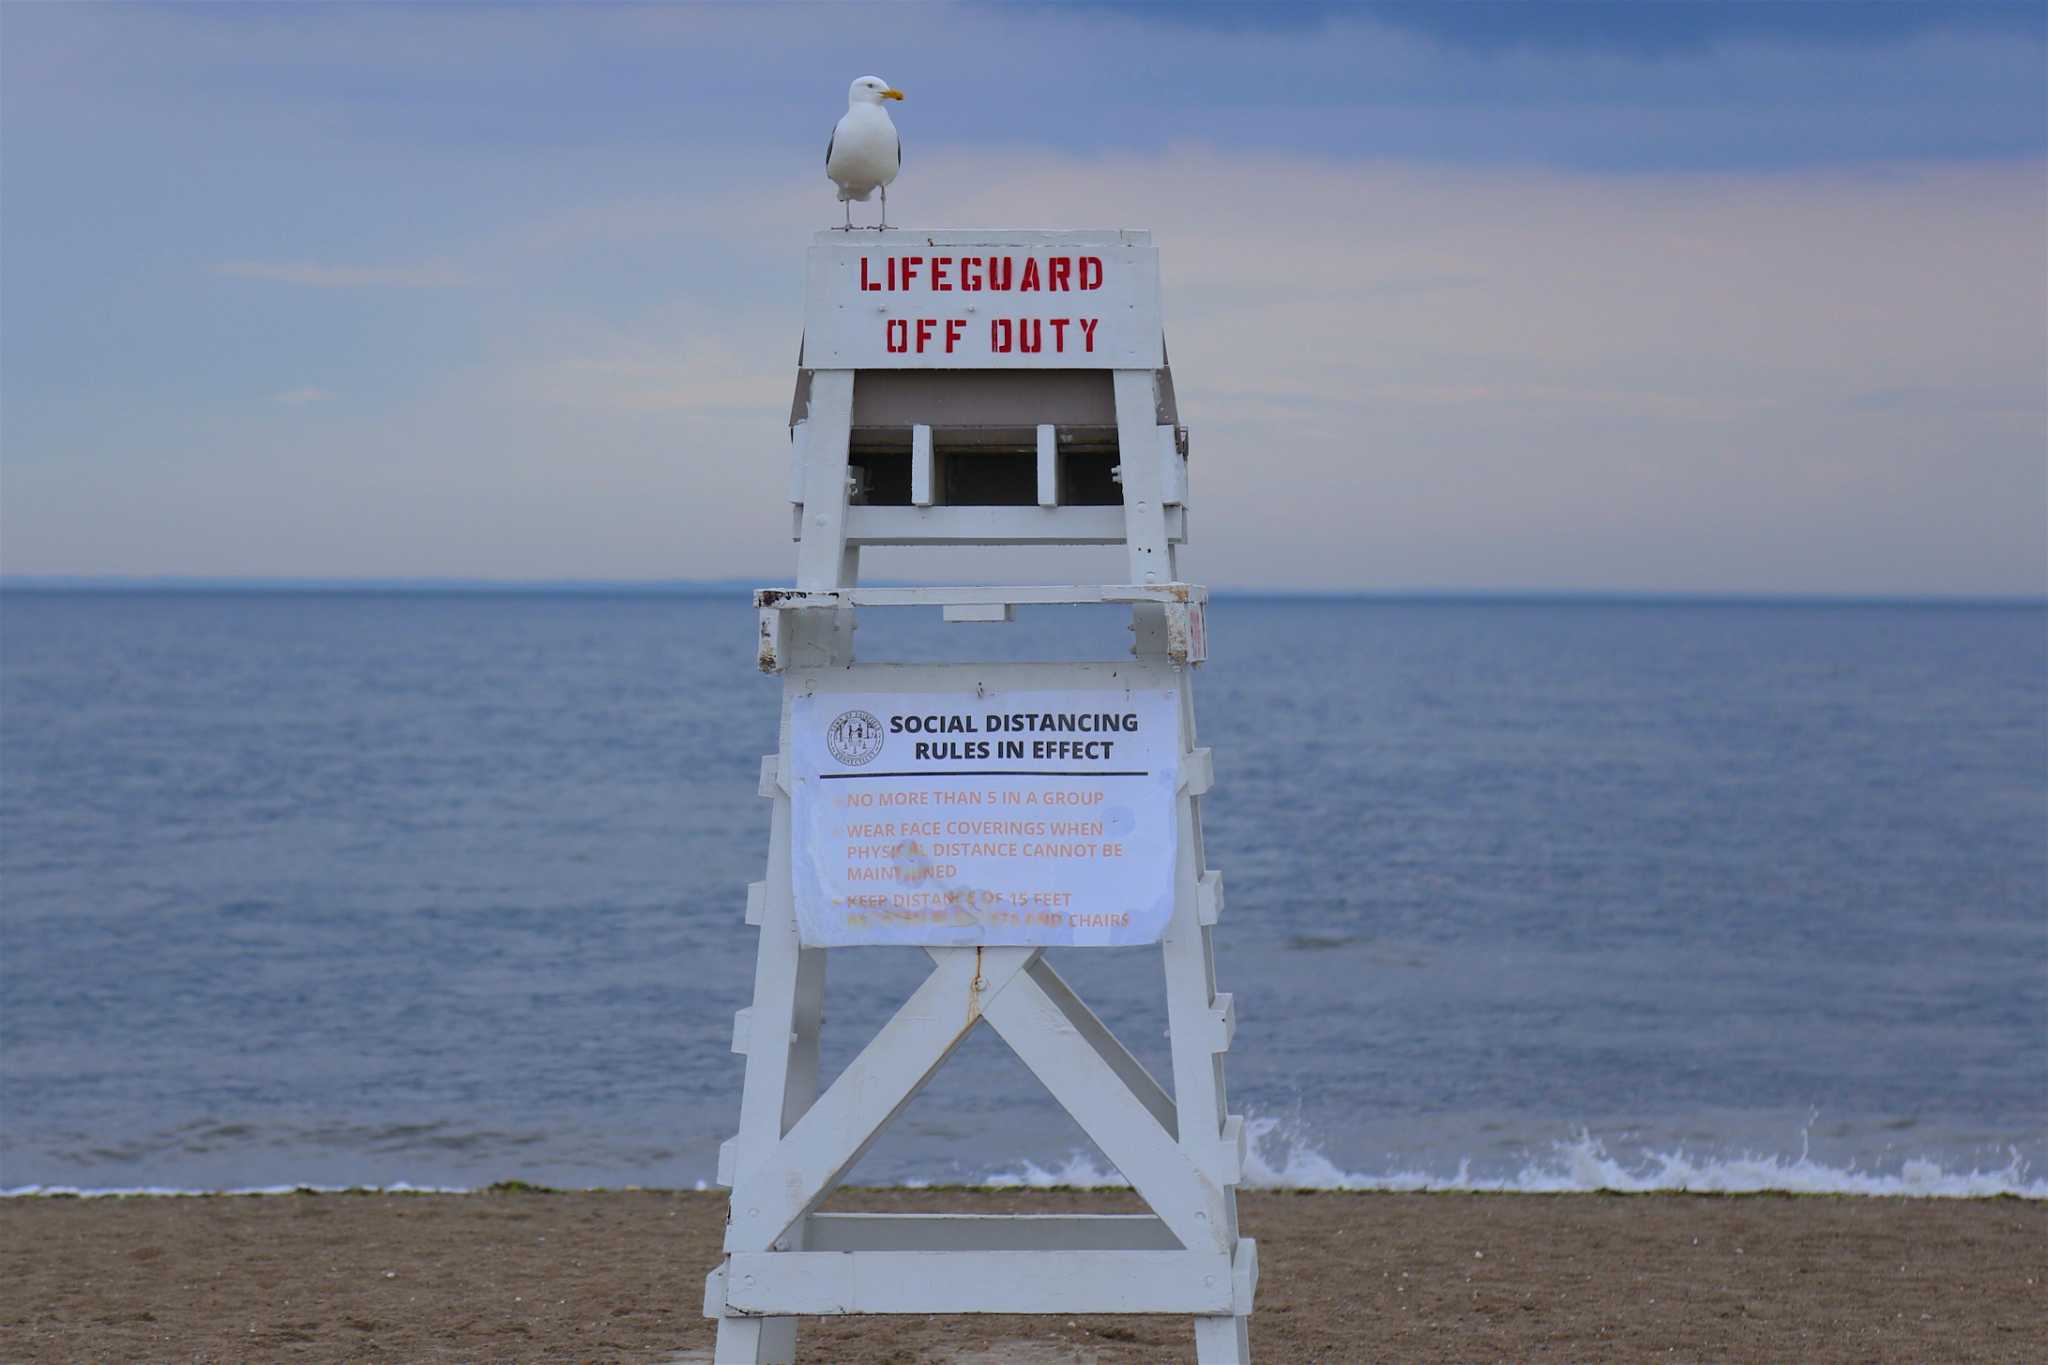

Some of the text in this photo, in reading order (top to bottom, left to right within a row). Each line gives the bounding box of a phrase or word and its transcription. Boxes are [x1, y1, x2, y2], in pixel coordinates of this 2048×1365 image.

[860, 256, 1104, 291] LIFEGUARD
[886, 319, 1098, 353] OFF DUTY
[889, 714, 978, 734] SOCIAL
[985, 712, 1138, 733] DISTANCING
[915, 740, 1114, 760] RULES IN EFFECT
[847, 791, 1105, 808] NO MORE THAN 5 IN A GROUP
[847, 821, 1104, 838] WEAR FACE COVERINGS WHEN
[933, 843, 1017, 857] DISTANCE
[1022, 842, 1098, 857] CANNOT
[1102, 842, 1123, 857] BE
[848, 864, 957, 880] MAINTNED
[848, 895, 888, 908] KEEP
[982, 890, 1005, 905] OF
[1010, 892, 1028, 907] 15
[1034, 891, 1072, 906] FEET
[1068, 912, 1129, 928] CHAIRS
